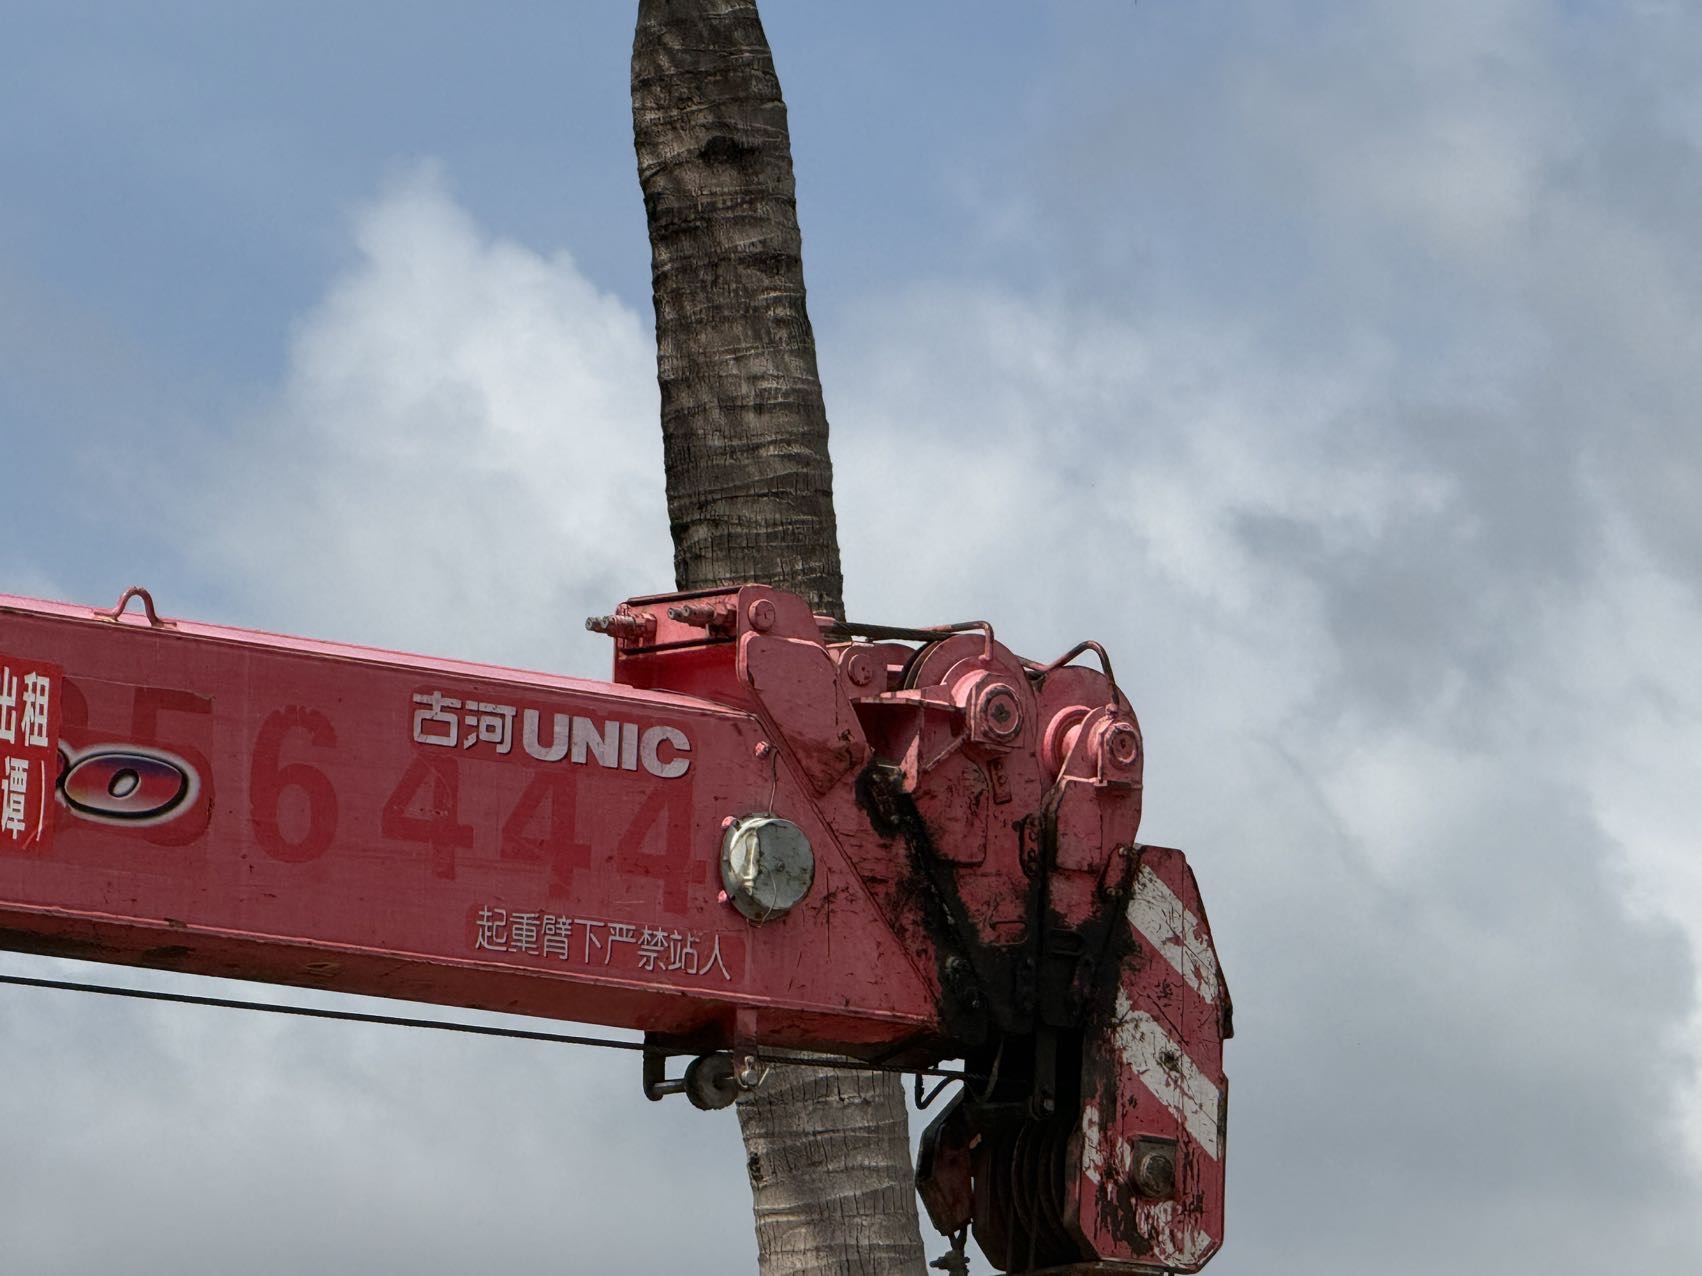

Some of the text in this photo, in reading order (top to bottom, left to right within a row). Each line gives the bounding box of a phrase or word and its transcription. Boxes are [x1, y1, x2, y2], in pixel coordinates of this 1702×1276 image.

[0, 666, 50, 747] 出租
[412, 690, 691, 779] 古河 UNIC
[475, 904, 731, 981] 起重臂下严禁站人
